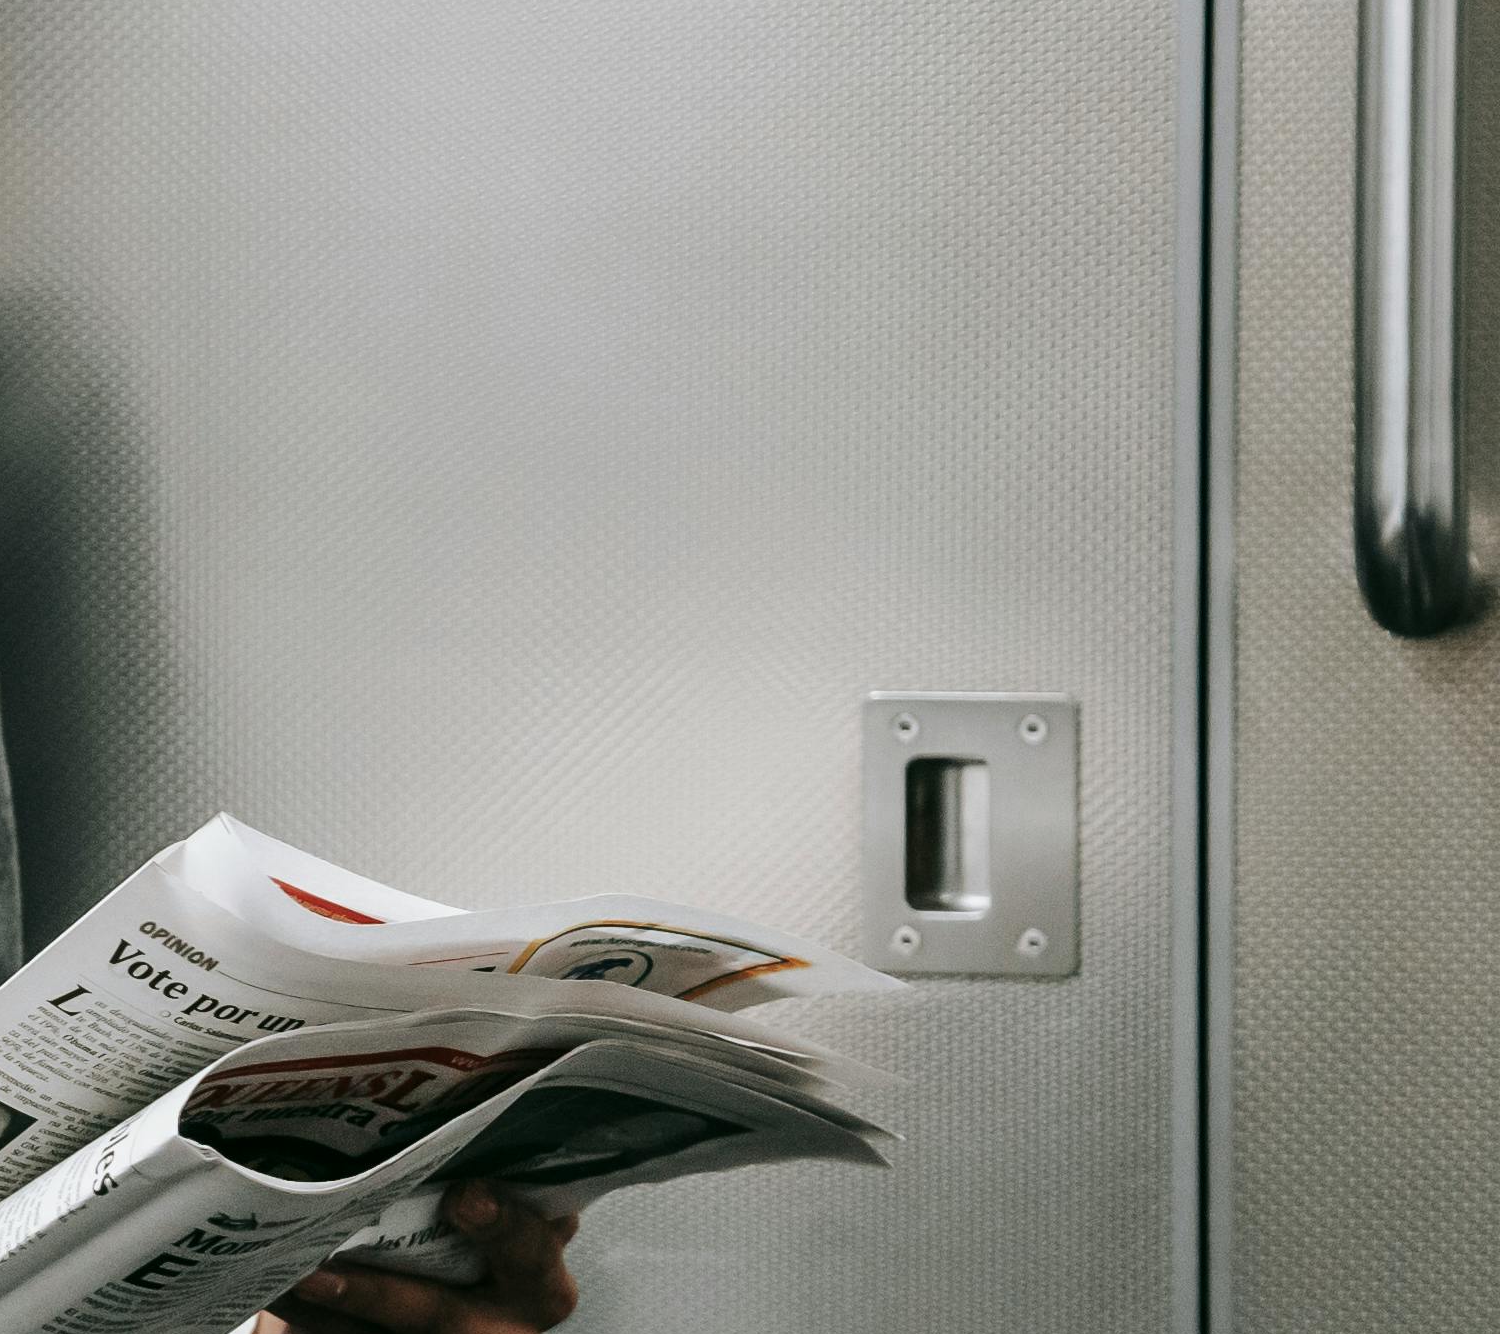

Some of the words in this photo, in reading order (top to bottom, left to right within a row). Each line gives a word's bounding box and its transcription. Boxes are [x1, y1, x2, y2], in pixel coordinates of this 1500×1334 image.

[140, 921, 219, 971] OPINION
[110, 939, 188, 999] Vote
[180, 994, 260, 1039] por
